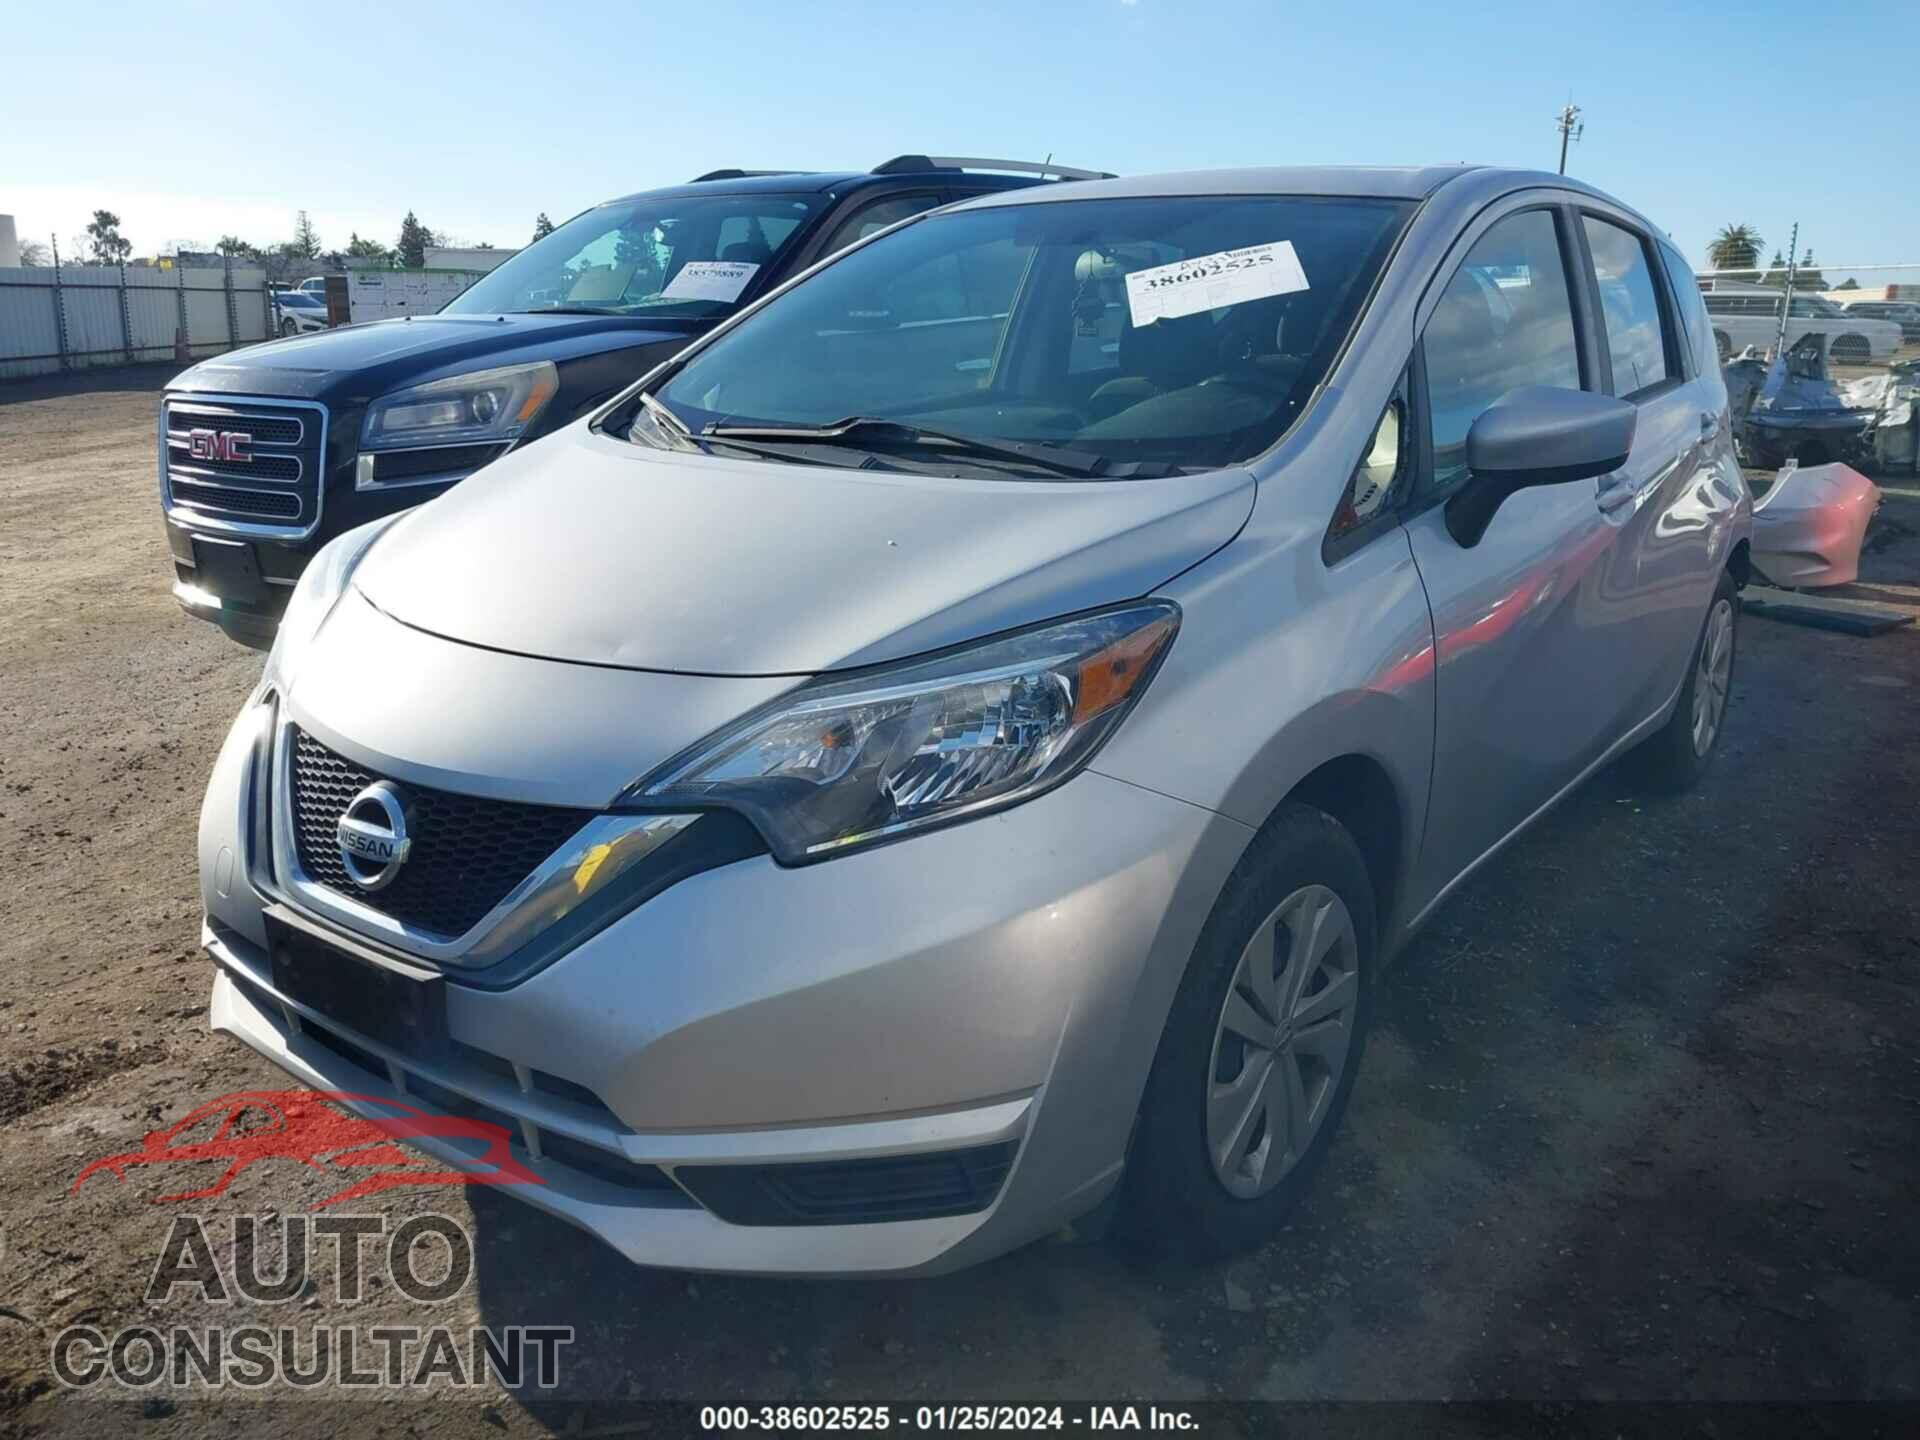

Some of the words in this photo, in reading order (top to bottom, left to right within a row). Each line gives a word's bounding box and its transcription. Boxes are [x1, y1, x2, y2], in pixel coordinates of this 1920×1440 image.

[1144, 254, 1274, 291] 38602525
[190, 428, 252, 462] GMC
[341, 828, 393, 857] NISSAN
